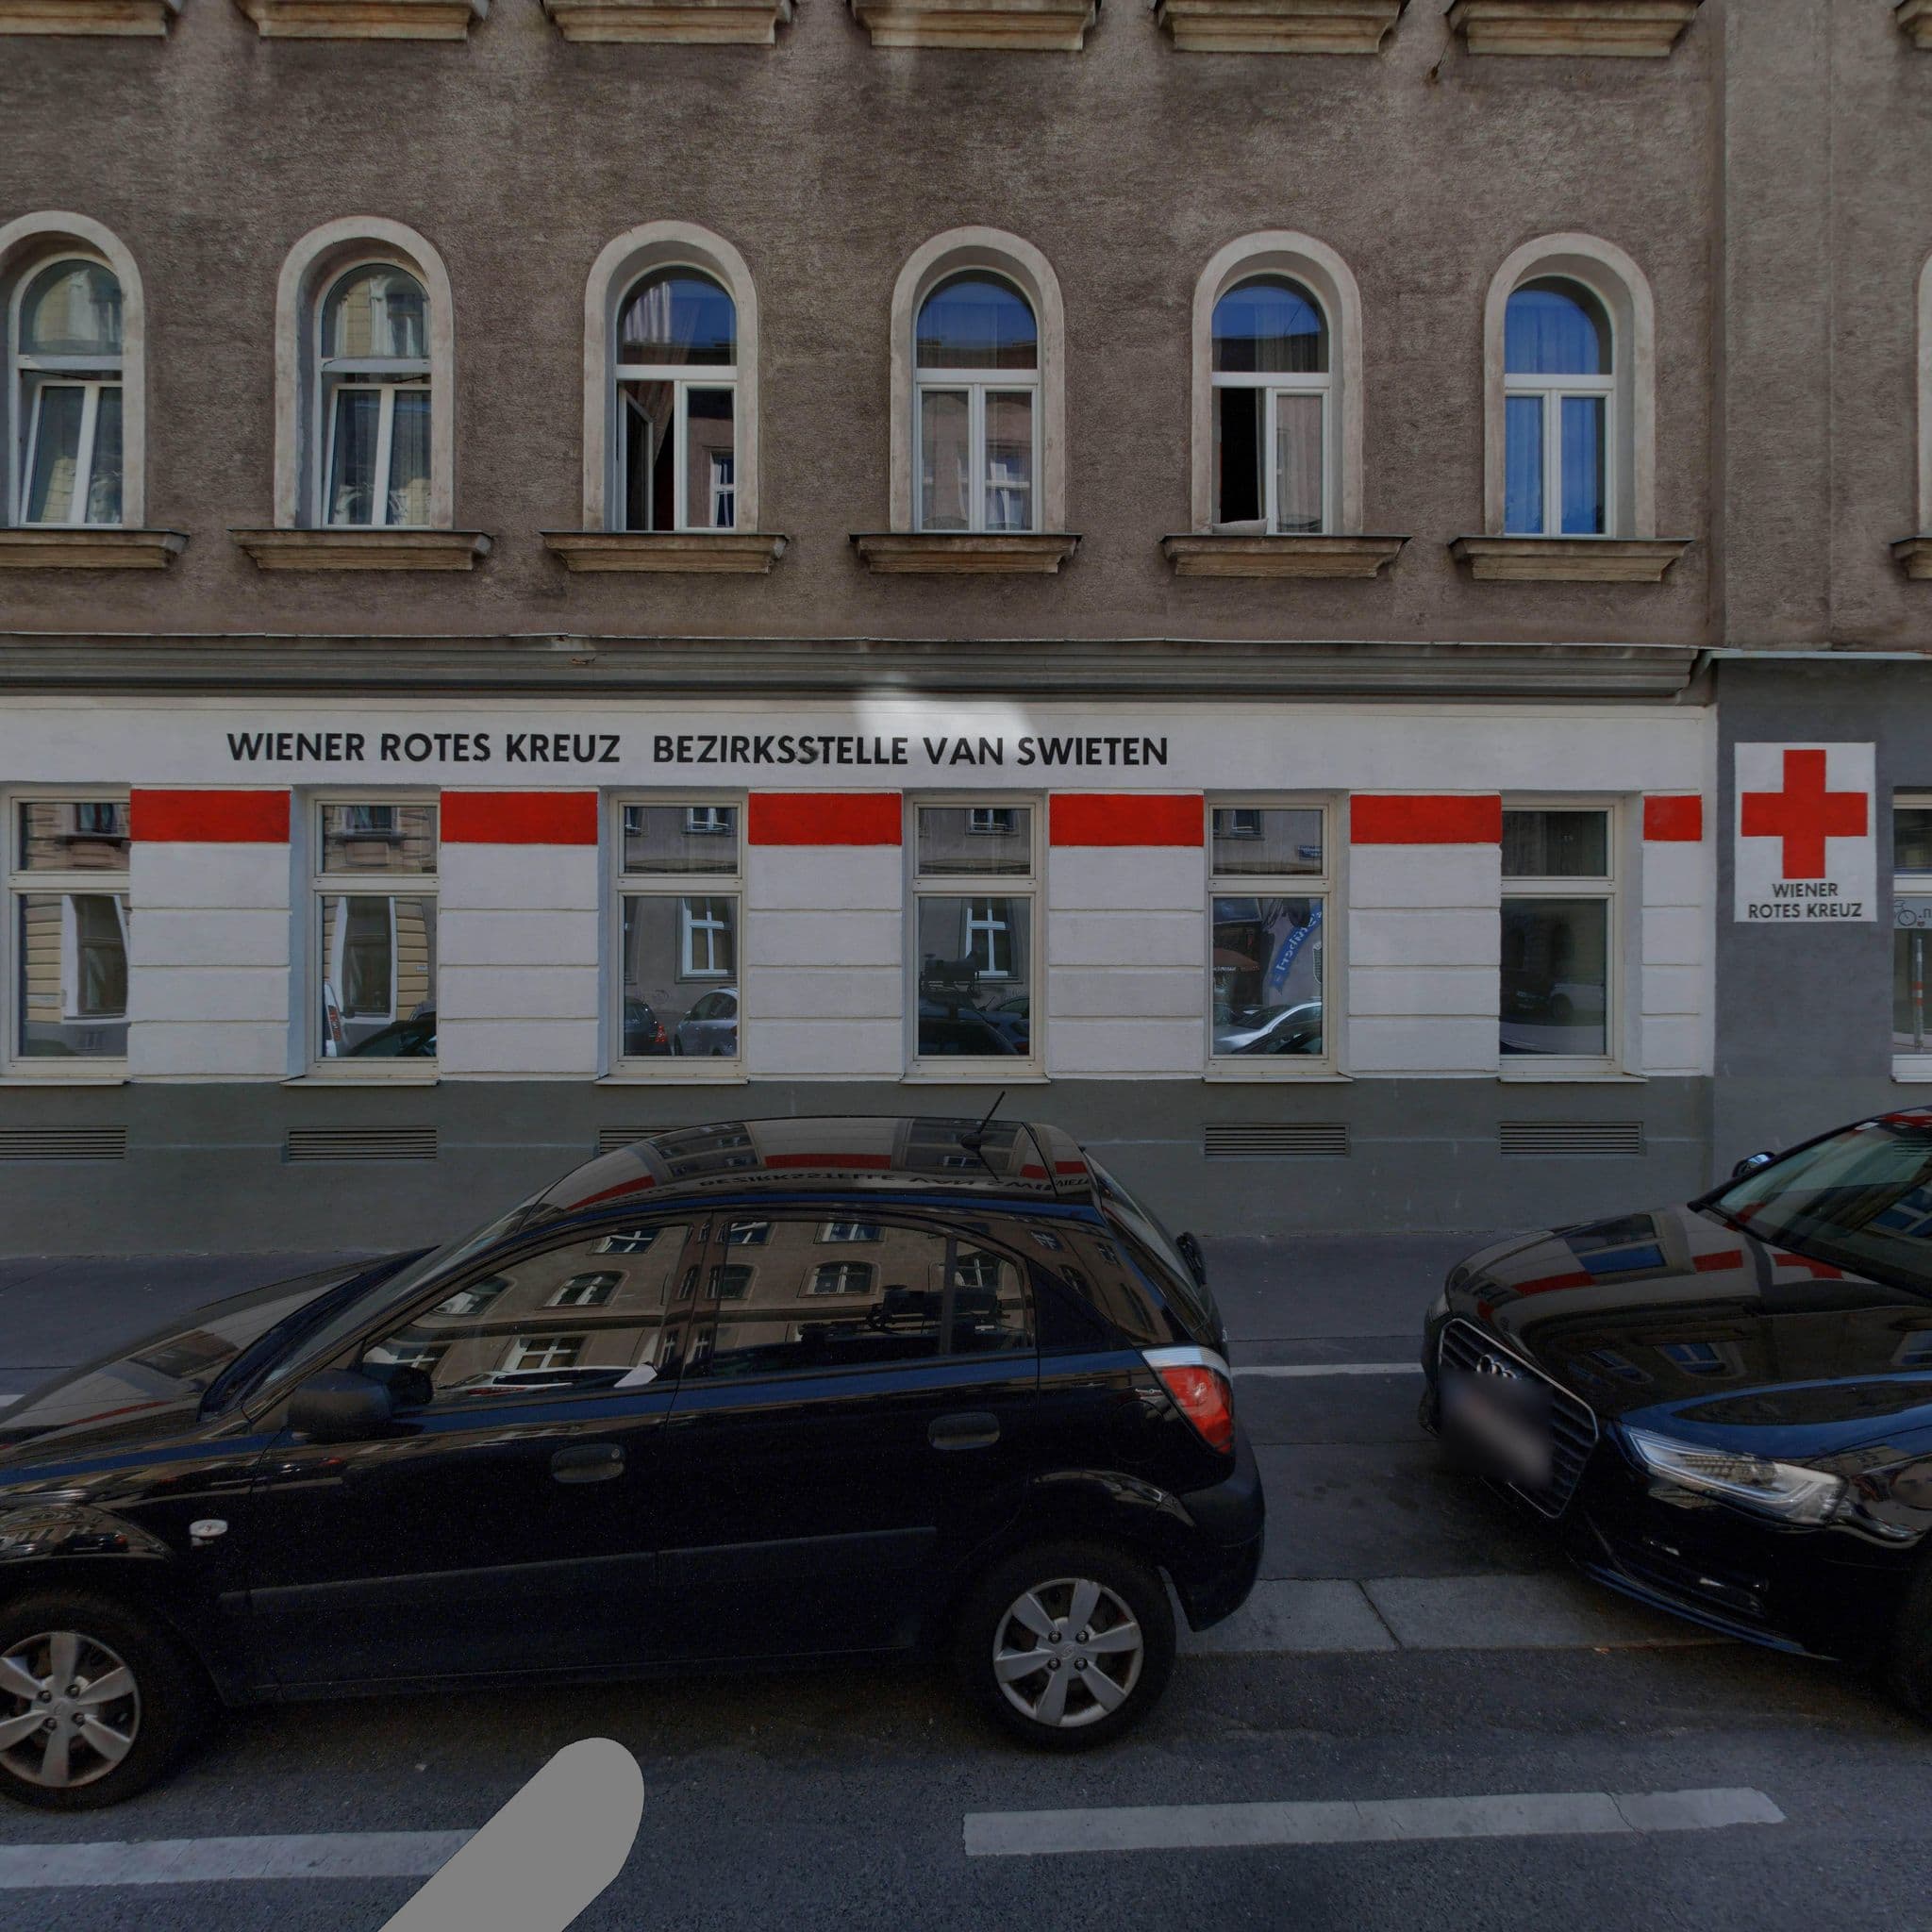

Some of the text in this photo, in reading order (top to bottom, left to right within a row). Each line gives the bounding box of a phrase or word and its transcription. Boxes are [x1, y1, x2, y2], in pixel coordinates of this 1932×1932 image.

[227, 732, 1168, 766] WIENER ROTES KREUZ BEZIRKSSTELLE VAN SWIETEN
[1772, 882, 1839, 898] WIENER
[1748, 902, 1862, 919] ROTES KREUZ
